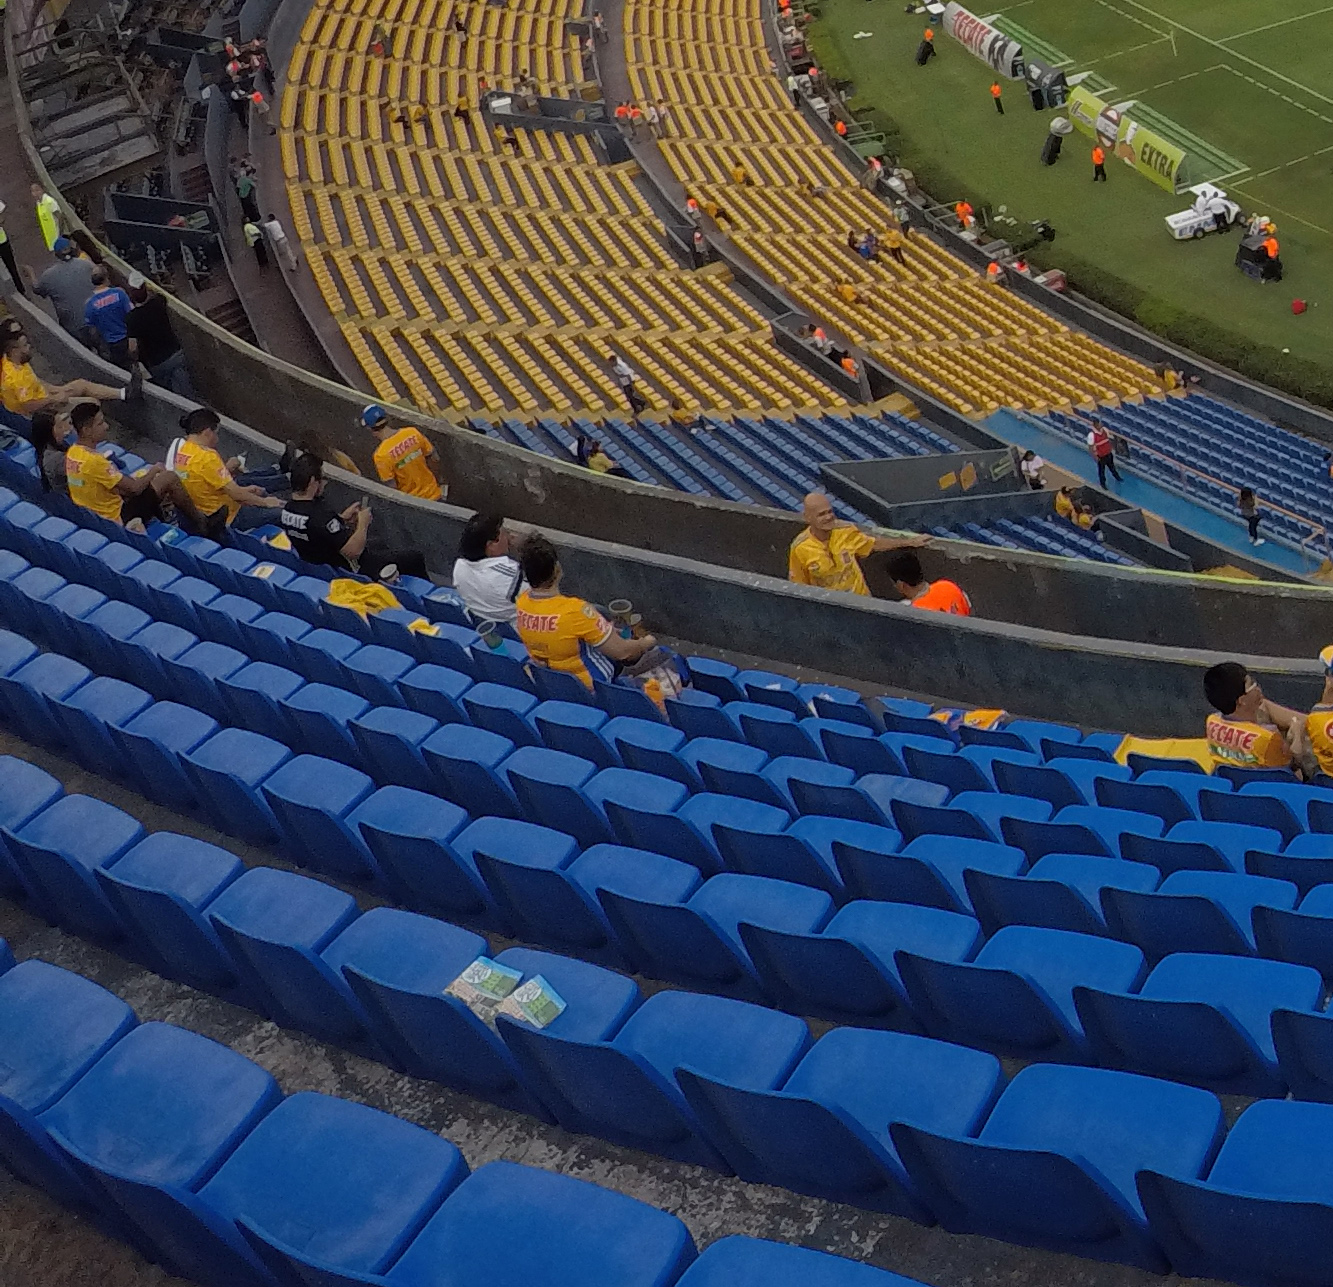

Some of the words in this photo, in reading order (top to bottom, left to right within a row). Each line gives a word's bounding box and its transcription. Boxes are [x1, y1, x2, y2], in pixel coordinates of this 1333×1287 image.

[1141, 142, 1174, 179] EXTRA
[518, 610, 561, 633] TECATE
[1206, 721, 1260, 751] TECATE
